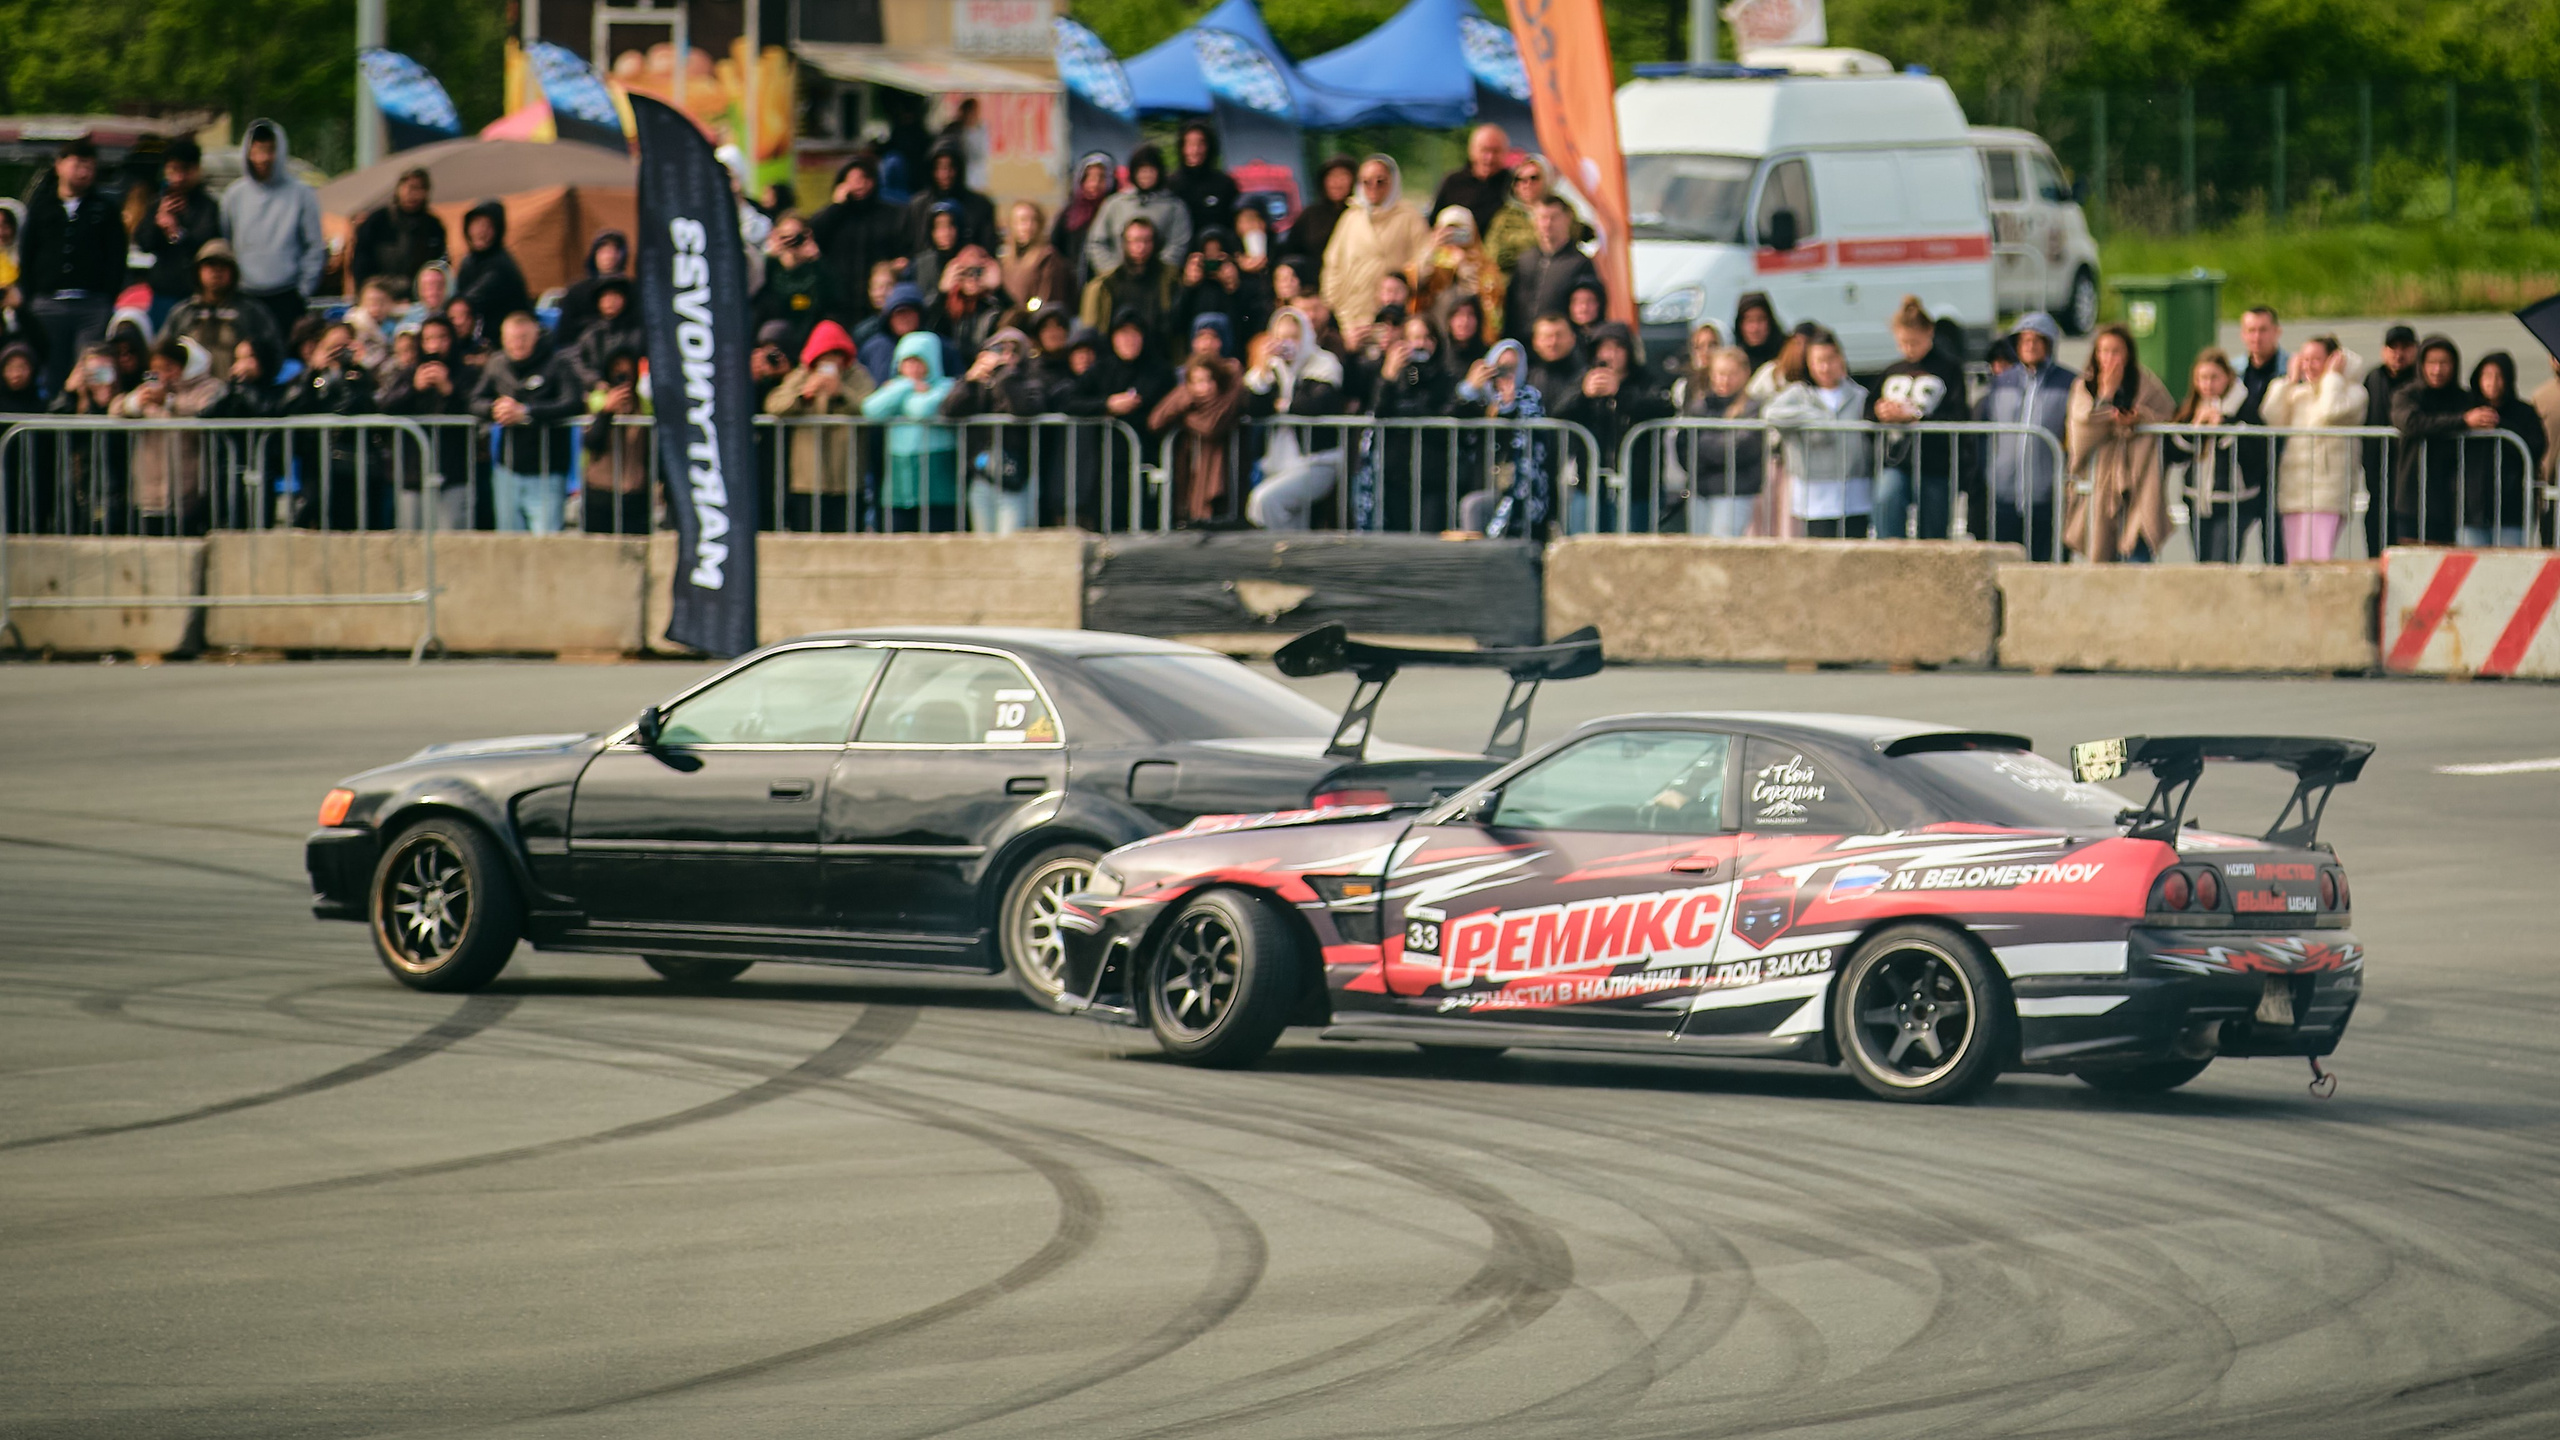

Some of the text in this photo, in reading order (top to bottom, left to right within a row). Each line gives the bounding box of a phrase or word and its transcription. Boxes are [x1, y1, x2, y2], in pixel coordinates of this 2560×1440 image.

[995, 702, 1026, 728] 10
[1757, 754, 1815, 785] Твой
[1751, 779, 1826, 804] Сахалин
[1890, 862, 2104, 890] N. BELOMESTNOV
[2287, 896, 2317, 912] ЦЕНЫ
[1406, 921, 1439, 951] 33
[1446, 892, 1724, 986] РЕМИКС
[1436, 948, 1833, 1014] ЗАПЧАСТИ В НАЛИЧИИ И ПОД ЗАКАЗ
